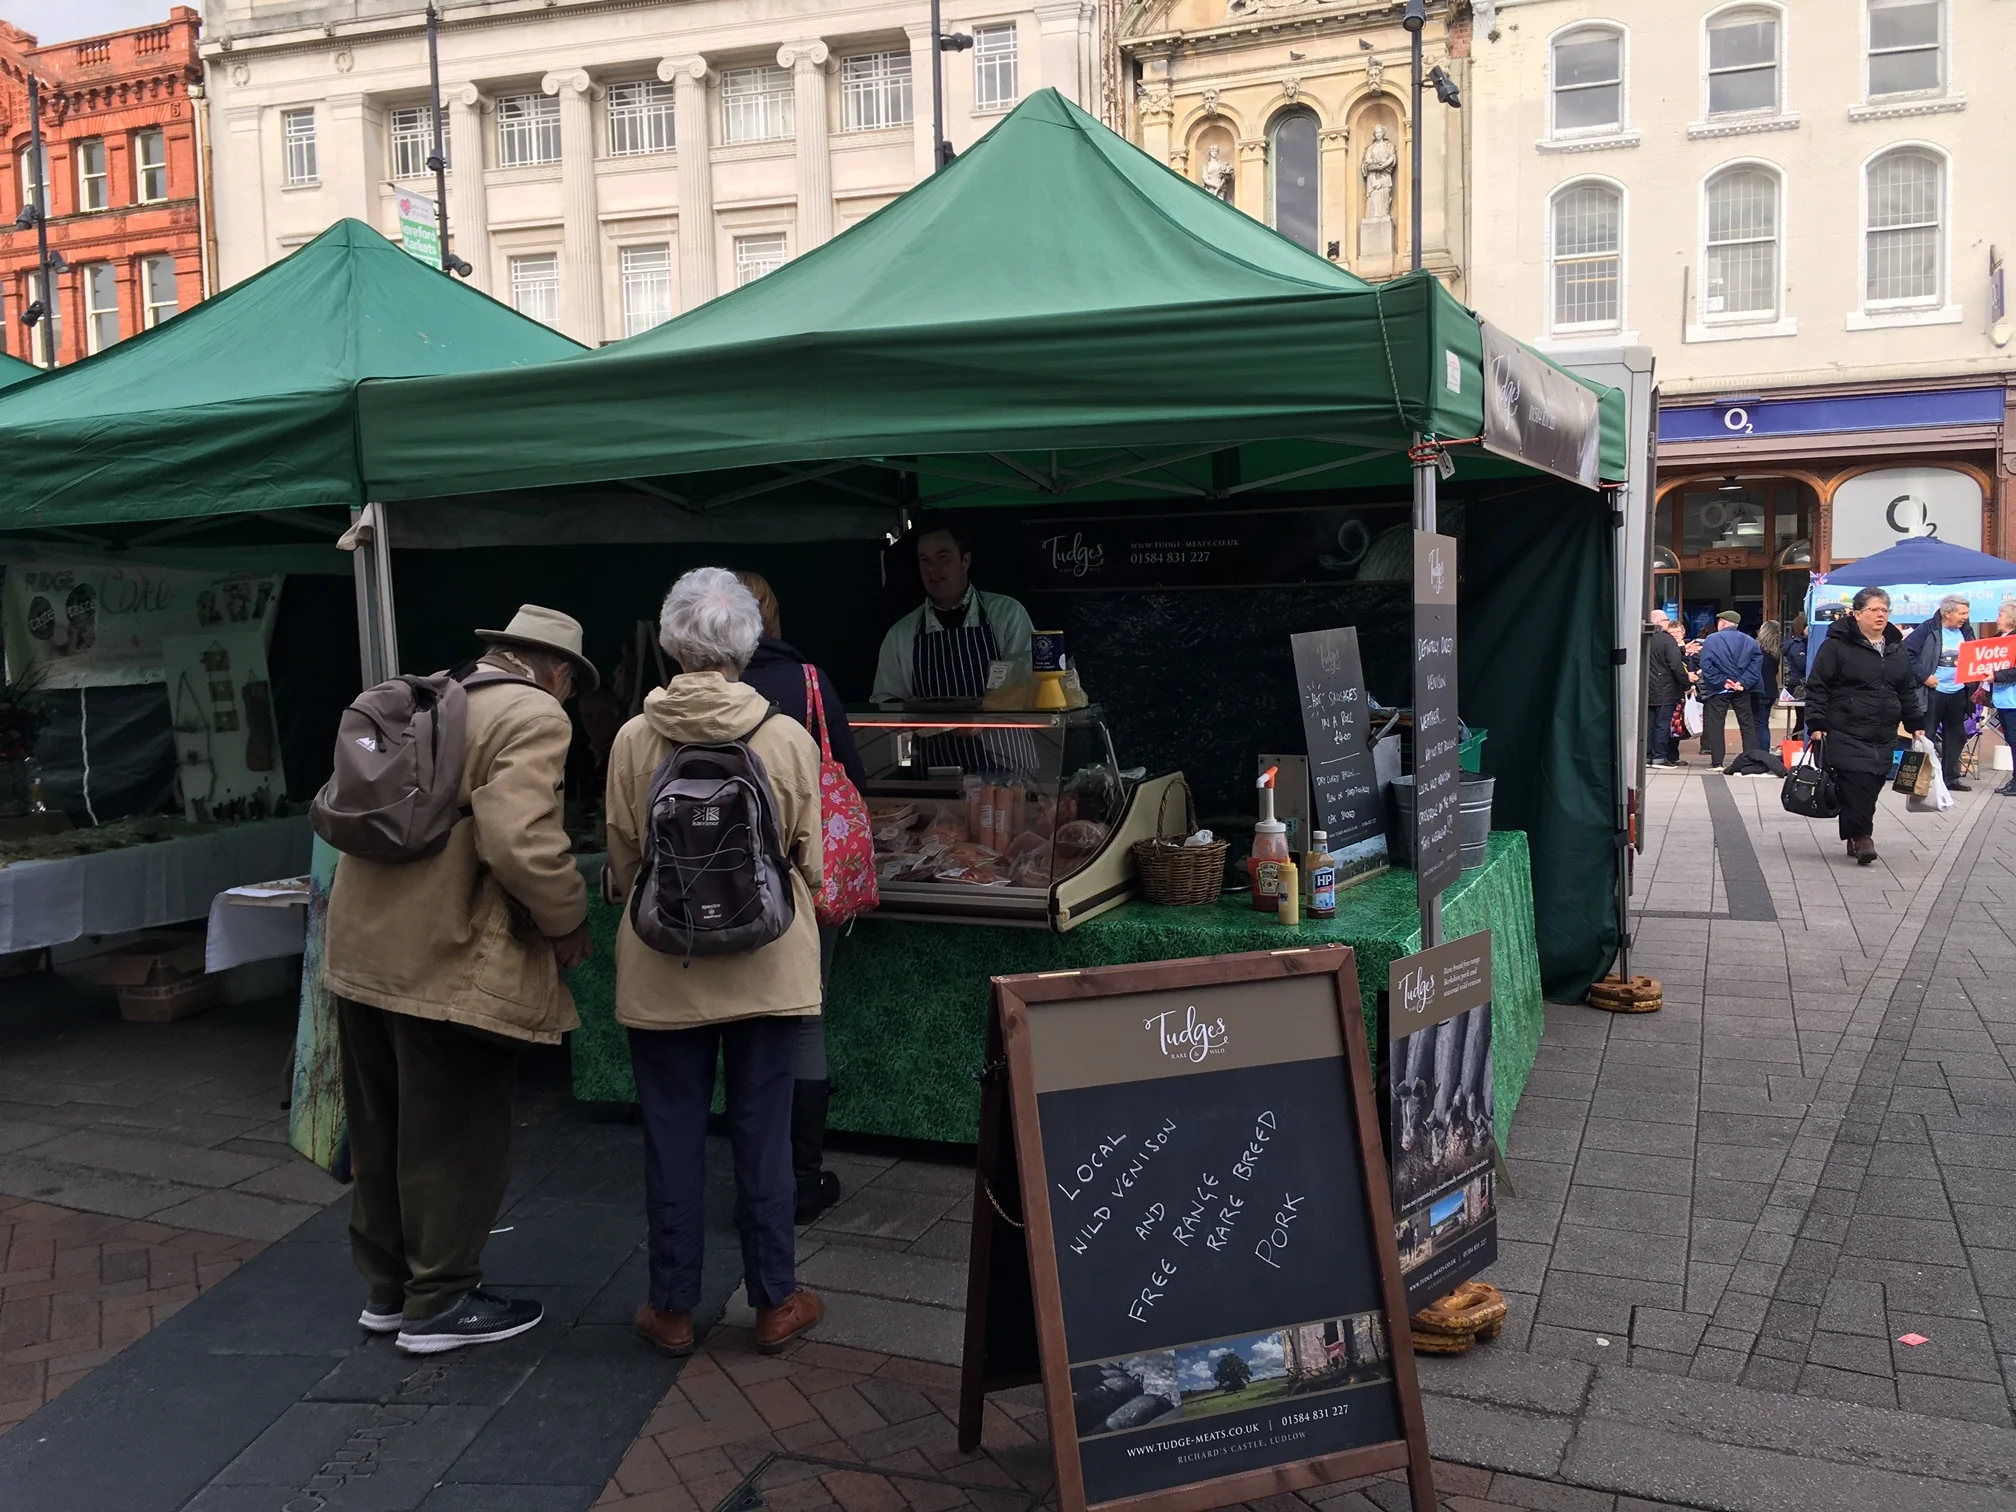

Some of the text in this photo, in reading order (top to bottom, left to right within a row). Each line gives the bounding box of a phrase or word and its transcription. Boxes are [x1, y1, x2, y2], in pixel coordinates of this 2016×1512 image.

[1724, 408, 1753, 434] O2
[1886, 495, 1938, 539] O2
[1041, 532, 1105, 577] Tudges
[1130, 539, 1239, 549] WWW.TUDGE-MEATS.CO.UK
[1130, 551, 1210, 564] 01584 831 227
[1968, 590, 1994, 599] FOR
[1968, 660, 2011, 676] Leave
[1975, 645, 2008, 660] Vote
[1316, 874, 1332, 886] HP
[1397, 966, 1435, 1013] Tudges
[1143, 1005, 1230, 1062] Tudges
[1058, 1133, 1127, 1201] LOCAL
[1070, 1118, 1177, 1255] WILD VENISON
[1206, 1110, 1277, 1252] RARE BREED
[1135, 1202, 1165, 1241] AND
[1254, 1192, 1305, 1269] PORK
[1128, 1172, 1220, 1323] FREE RANGE
[457, 1315, 478, 1325] FILA
[1126, 1404, 1350, 1458] WWW.TUDGE-MEATS.CO.UK 01584 831 227
[1270, 1430, 1307, 1446] LUDLOW
